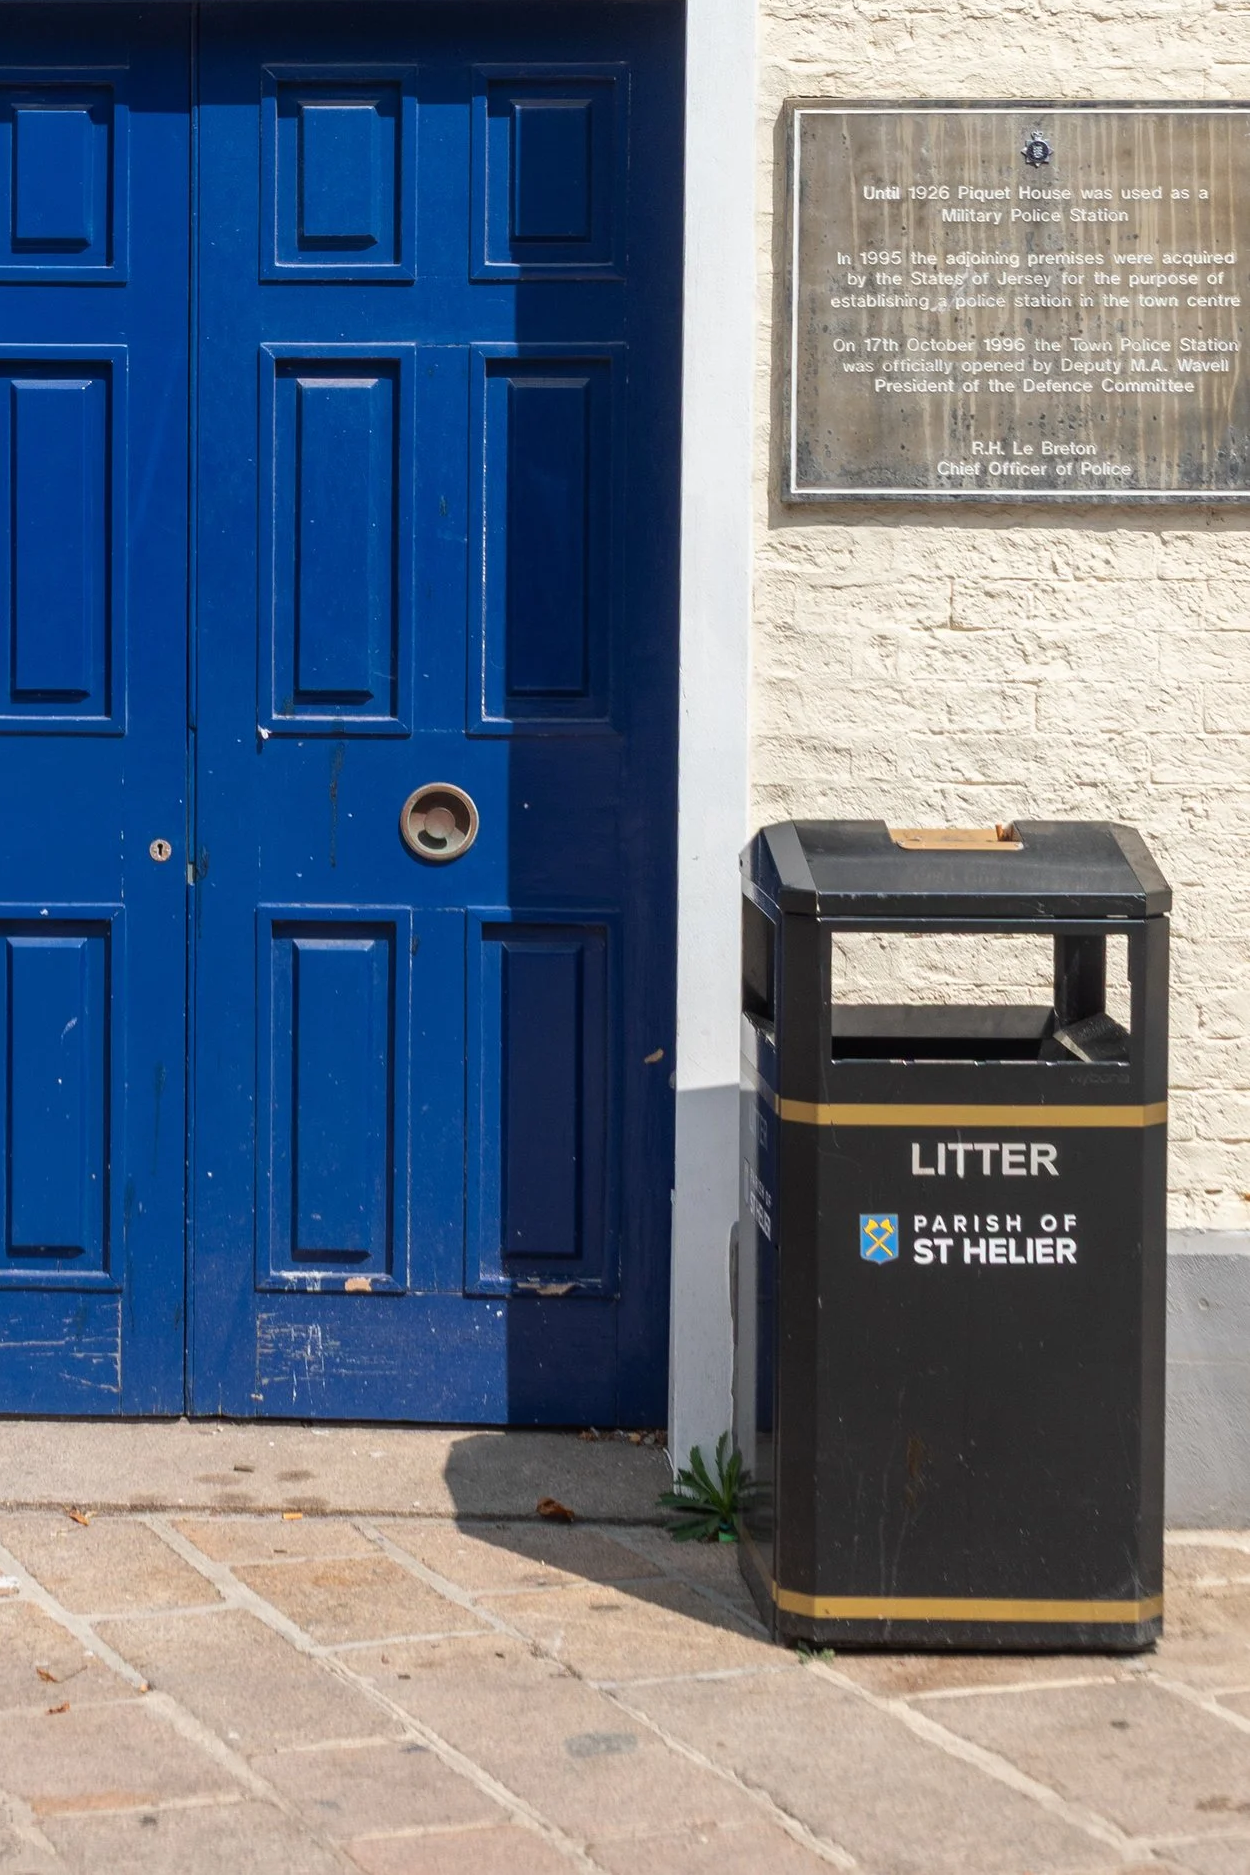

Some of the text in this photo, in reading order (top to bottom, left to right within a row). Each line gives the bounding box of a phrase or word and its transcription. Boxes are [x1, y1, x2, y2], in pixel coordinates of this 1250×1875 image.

[864, 185, 1208, 202] Until 1926 Piquet House was used as a
[942, 208, 1128, 224] Military Police Station
[838, 251, 1235, 268] In 1995 the adjoining premises were acquired
[848, 272, 1224, 289] by the States of Jersey for the purpose of
[831, 294, 1241, 311] establishing a police station in the town centre
[833, 338, 1239, 352] On 17th October 1996 the Town Police Station
[843, 358, 1229, 374] was officially opened by Deputy M.A. Wavell
[875, 378, 1194, 392] President of the Defence Committee
[972, 441, 1097, 455] R.H. Le Breton
[938, 461, 1131, 475] Chief Officer of Police
[911, 1142, 1060, 1176] LITTER
[913, 1213, 1078, 1233] PARISH OF
[913, 1237, 1078, 1265] ST HELIER
